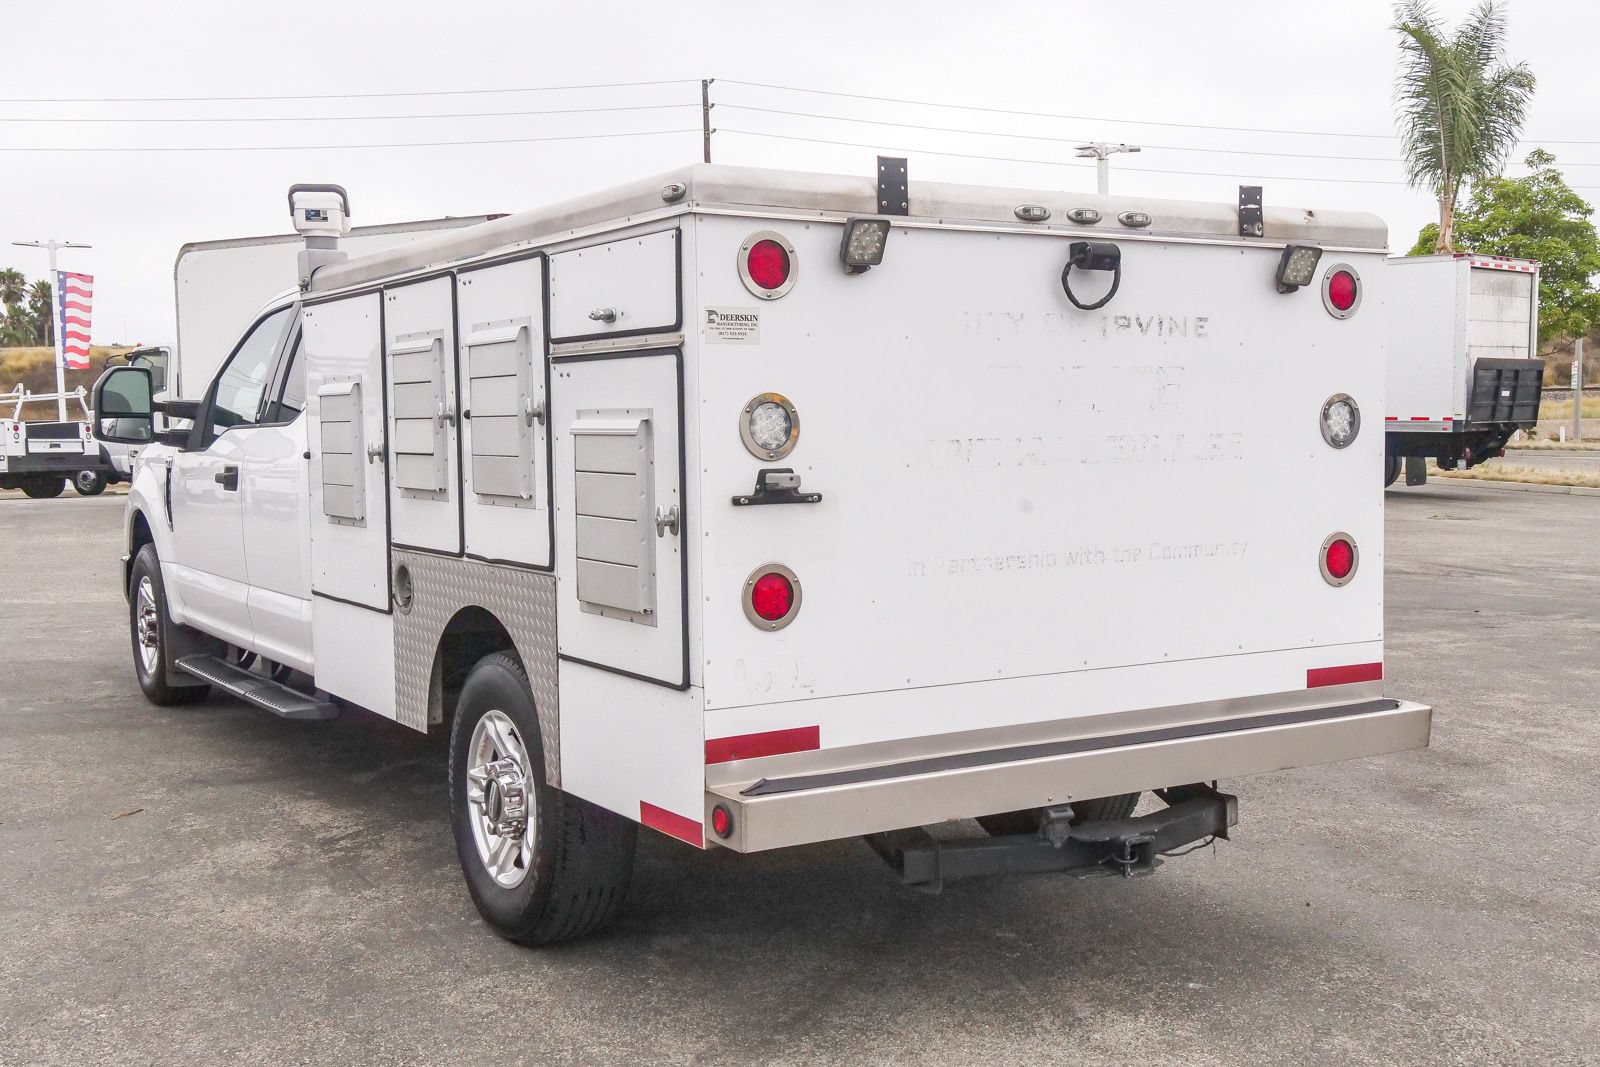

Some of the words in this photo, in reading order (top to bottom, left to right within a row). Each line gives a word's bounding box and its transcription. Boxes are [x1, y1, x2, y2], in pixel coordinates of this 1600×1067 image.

[720, 313, 758, 322] DEERSKIN
[1102, 314, 1209, 338] IRVINE
[936, 549, 1057, 576] Partnership
[1064, 545, 1105, 567] with
[1112, 544, 1142, 564] the
[1149, 540, 1249, 562] Community
